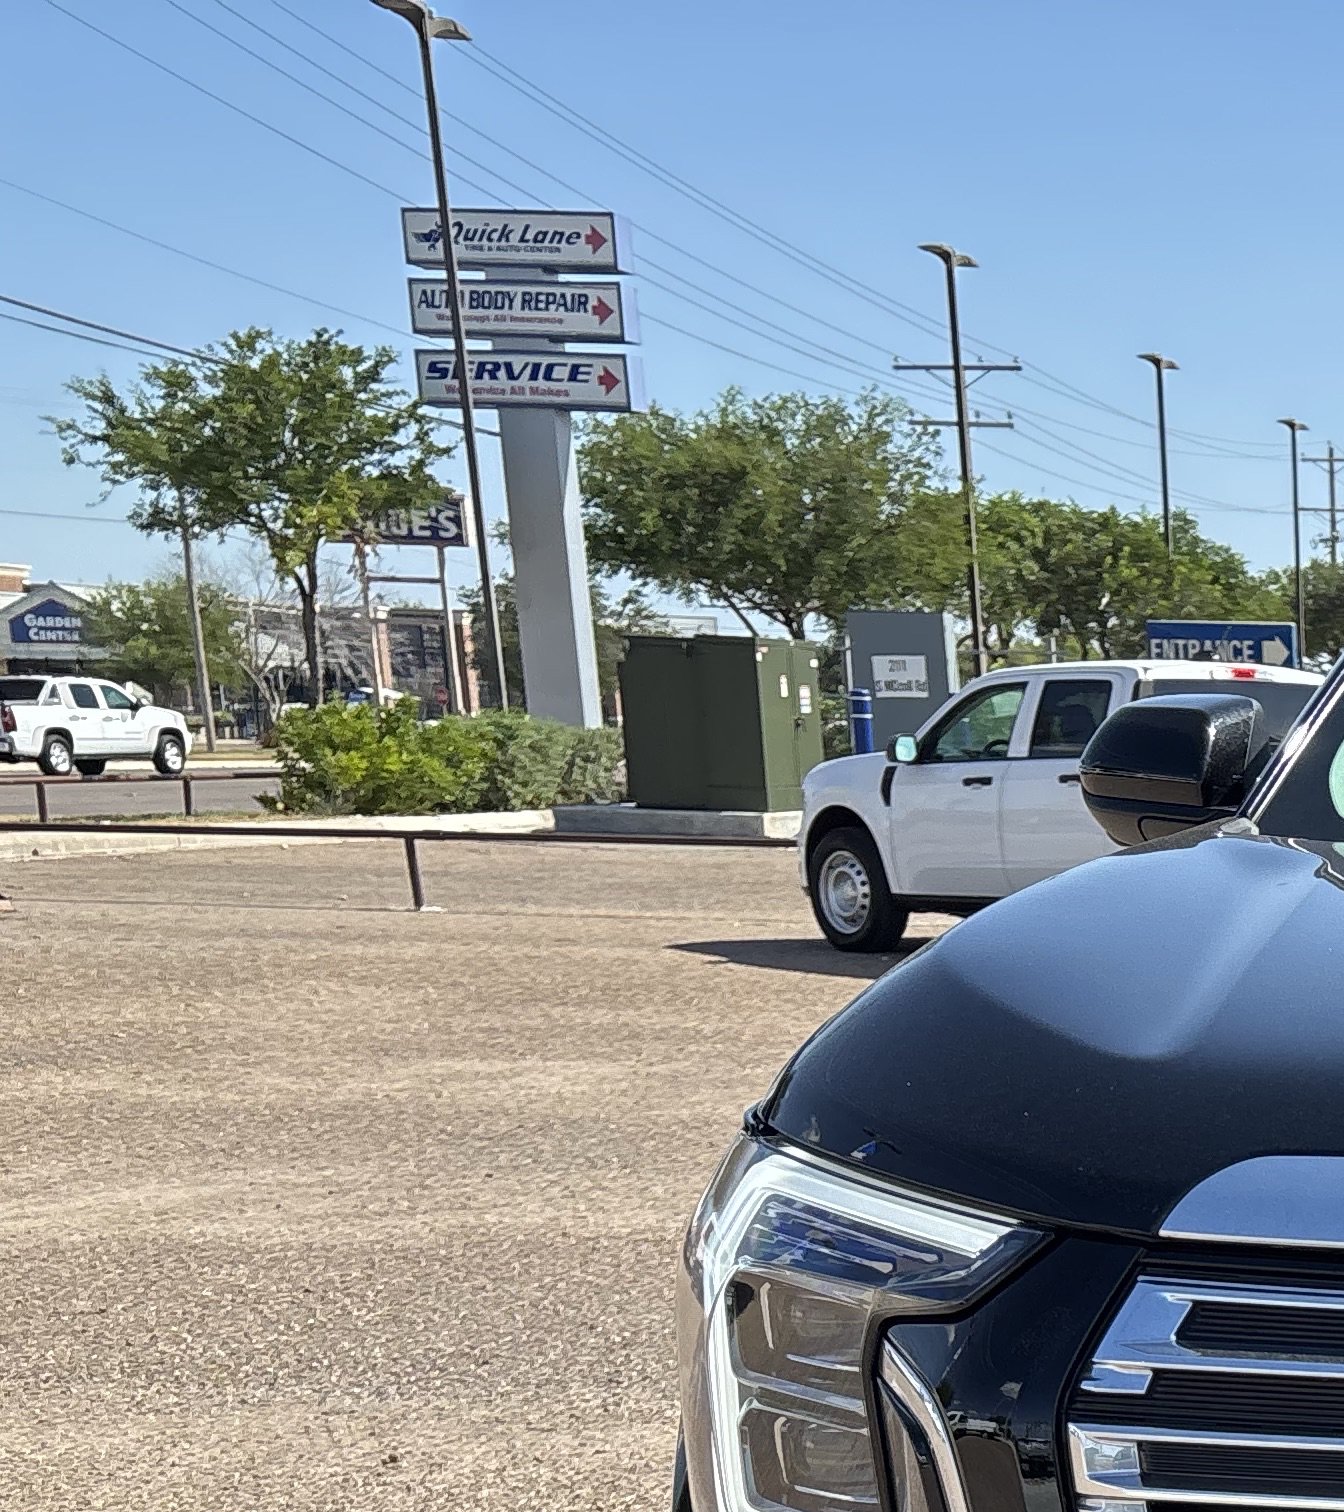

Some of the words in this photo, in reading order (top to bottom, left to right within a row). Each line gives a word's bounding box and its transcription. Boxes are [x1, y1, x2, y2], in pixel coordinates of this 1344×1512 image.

[518, 223, 582, 246] Lane
[469, 290, 518, 310] BODY
[520, 291, 589, 313] REPAIR
